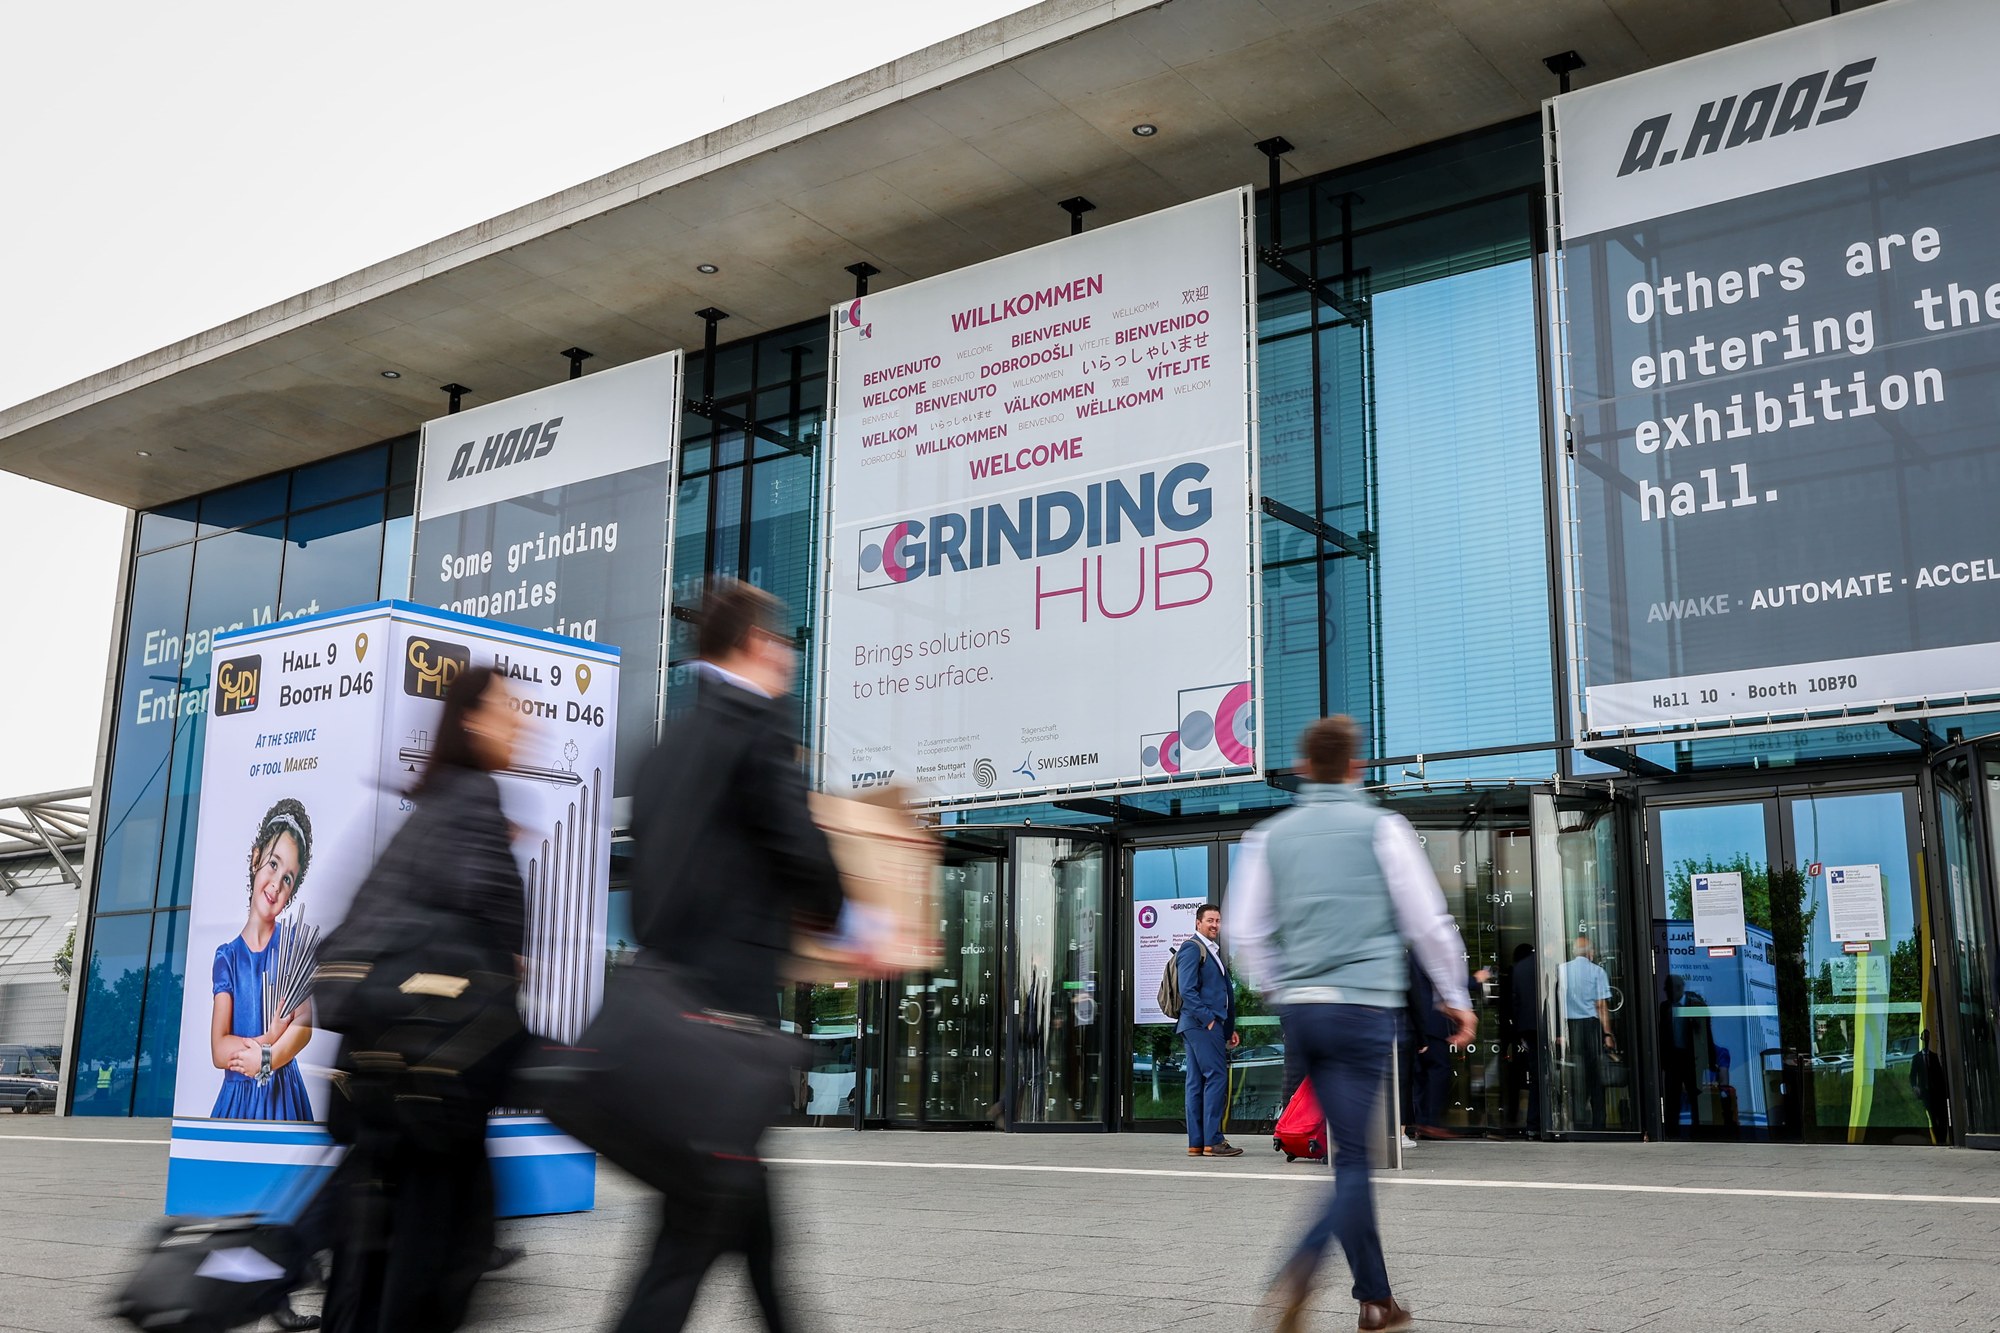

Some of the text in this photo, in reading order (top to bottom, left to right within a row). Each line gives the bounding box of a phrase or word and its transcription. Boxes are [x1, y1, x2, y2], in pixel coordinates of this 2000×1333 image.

[1626, 226, 1941, 324] Others are
[951, 273, 1103, 333] WILLKOMMEN
[1181, 285, 1209, 305] 欢迎
[863, 300, 1160, 387] BENVENUTO WELCOME BIENVENUE WËLLKOMM
[1082, 331, 1210, 375] いらっしゃいませ
[1631, 282, 2000, 389] entering the
[862, 309, 1210, 408] WELCOME BENVENUTO DOBRODOŠLI VÍTEJTE BIENVENIDO
[862, 369, 1064, 426] BIENVENUE BENVENUTO WILLKOMMEN
[862, 354, 1211, 448] WELKOM VÄLKOMMEN VÍTEJTE
[1112, 375, 1130, 389] 欢迎
[861, 379, 1211, 467] DOBRODOŠLI WILLKOMMEN BIENVENIDO WËLLKOMM WELKOM
[930, 409, 992, 431] いらっしゃいませ
[1635, 367, 1944, 454] exhibition
[969, 436, 1083, 481] WELCOME
[1639, 463, 1778, 522] hall.
[884, 462, 1213, 583] GRINDING
[440, 522, 618, 582] Some grinding
[1035, 537, 1213, 631] HUB
[1647, 558, 2000, 623] AWAKE AUTOMATE ACCEL
[143, 621, 243, 669] Einga
[327, 642, 337, 665] 9
[854, 626, 1011, 667] Brings solutions
[339, 671, 374, 698] D46
[550, 665, 562, 687] 9
[852, 664, 994, 699] to the surface.
[1653, 674, 1857, 709] Hall 10 Booth 10B70
[508, 697, 604, 728] OOTH D46
[1021, 723, 1057, 735] Trägerschaft
[864, 745, 882, 753] Messe
[882, 744, 892, 752] des
[923, 735, 970, 747] Zusammenarbeit
[923, 745, 959, 756] cooperation
[959, 743, 972, 751] with
[1021, 733, 1059, 744] Sponsorship
[851, 769, 895, 789] VDW
[916, 761, 966, 774] Messe Stuttgart
[916, 771, 966, 783] Mitten im Markt
[1037, 752, 1099, 770] SWISSMEM
